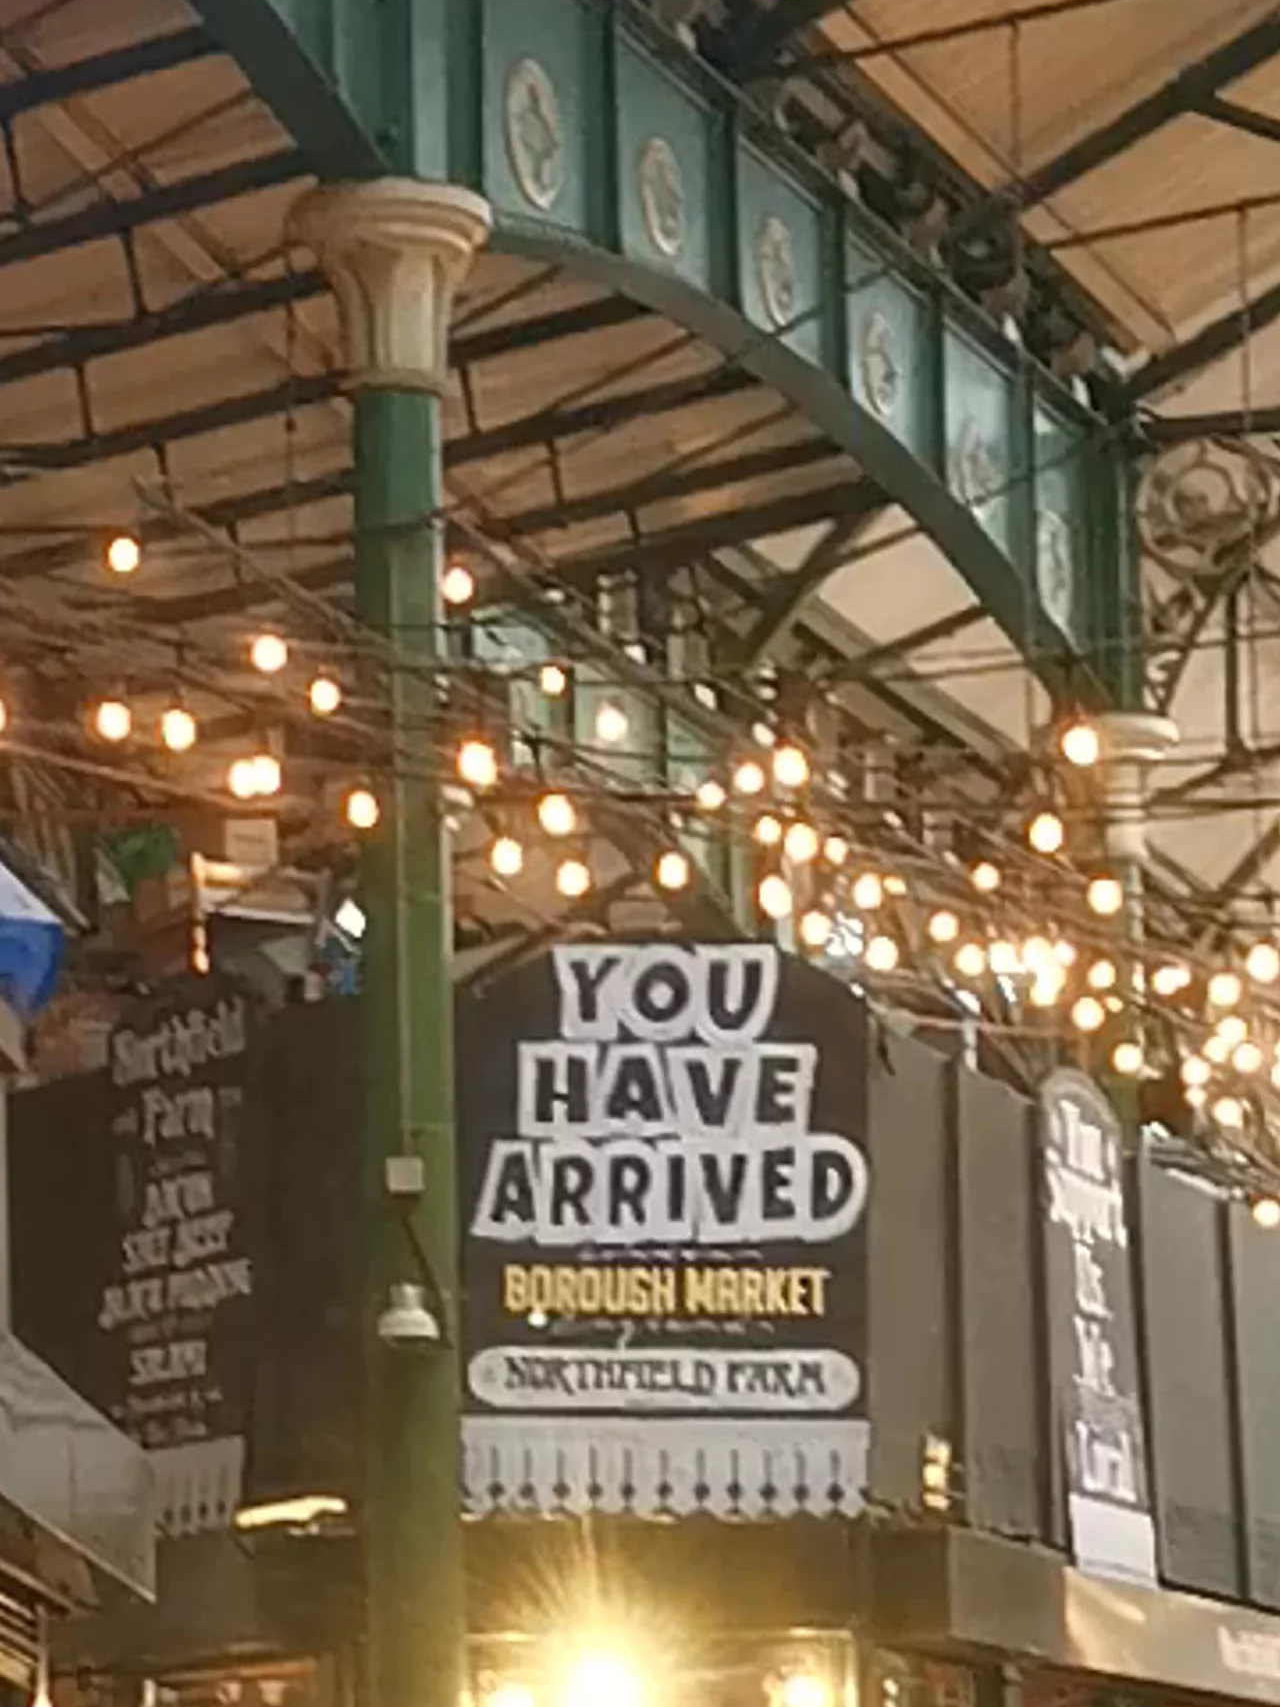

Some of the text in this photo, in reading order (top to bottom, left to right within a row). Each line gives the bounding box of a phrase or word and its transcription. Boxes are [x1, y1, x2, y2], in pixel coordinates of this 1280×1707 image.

[565, 954, 765, 1034] YOU
[531, 1052, 806, 1129] HAVE
[486, 1143, 856, 1228] ARRIVED
[684, 1266, 831, 1314] MARKET
